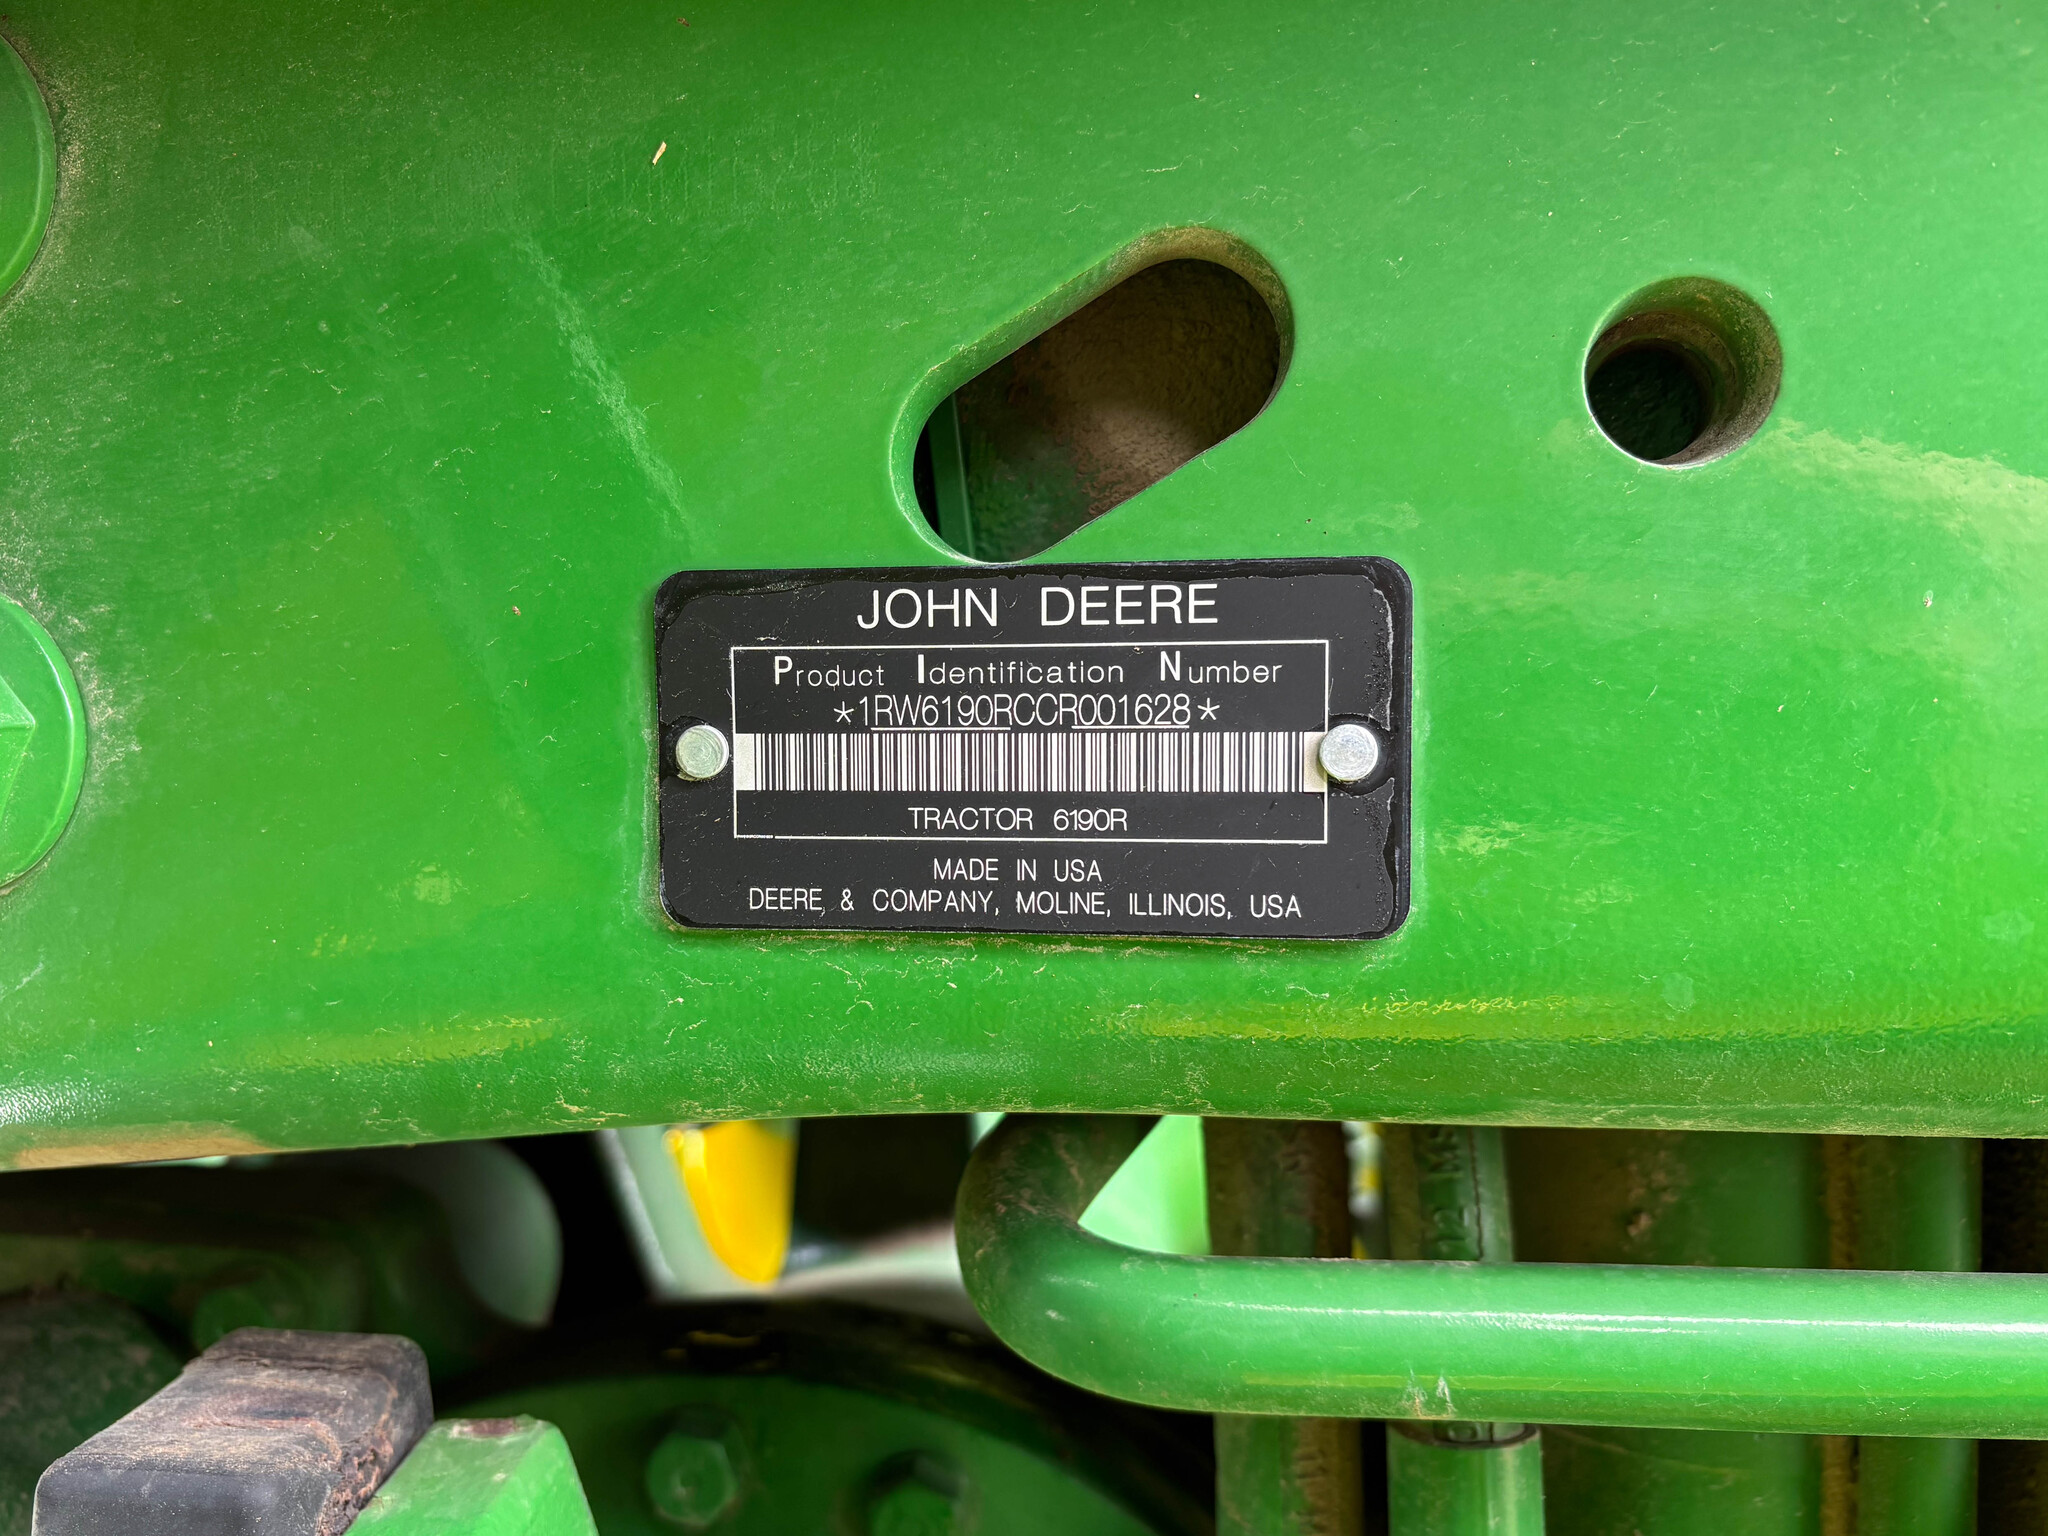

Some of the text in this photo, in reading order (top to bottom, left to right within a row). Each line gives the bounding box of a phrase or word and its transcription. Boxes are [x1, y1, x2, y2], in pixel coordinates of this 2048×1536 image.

[857, 583, 1219, 630] JOHN DEERE
[774, 650, 1284, 689] Product Identification Number
[907, 806, 1128, 832] TRACTOR 6190R
[933, 857, 1103, 883] MADE IN USA
[840, 888, 855, 912] &
[872, 888, 999, 916] COMPANY,
[1015, 890, 1112, 918] MOLINE,
[1129, 892, 1232, 921] ILLINOIS,
[1250, 894, 1302, 919] USA
